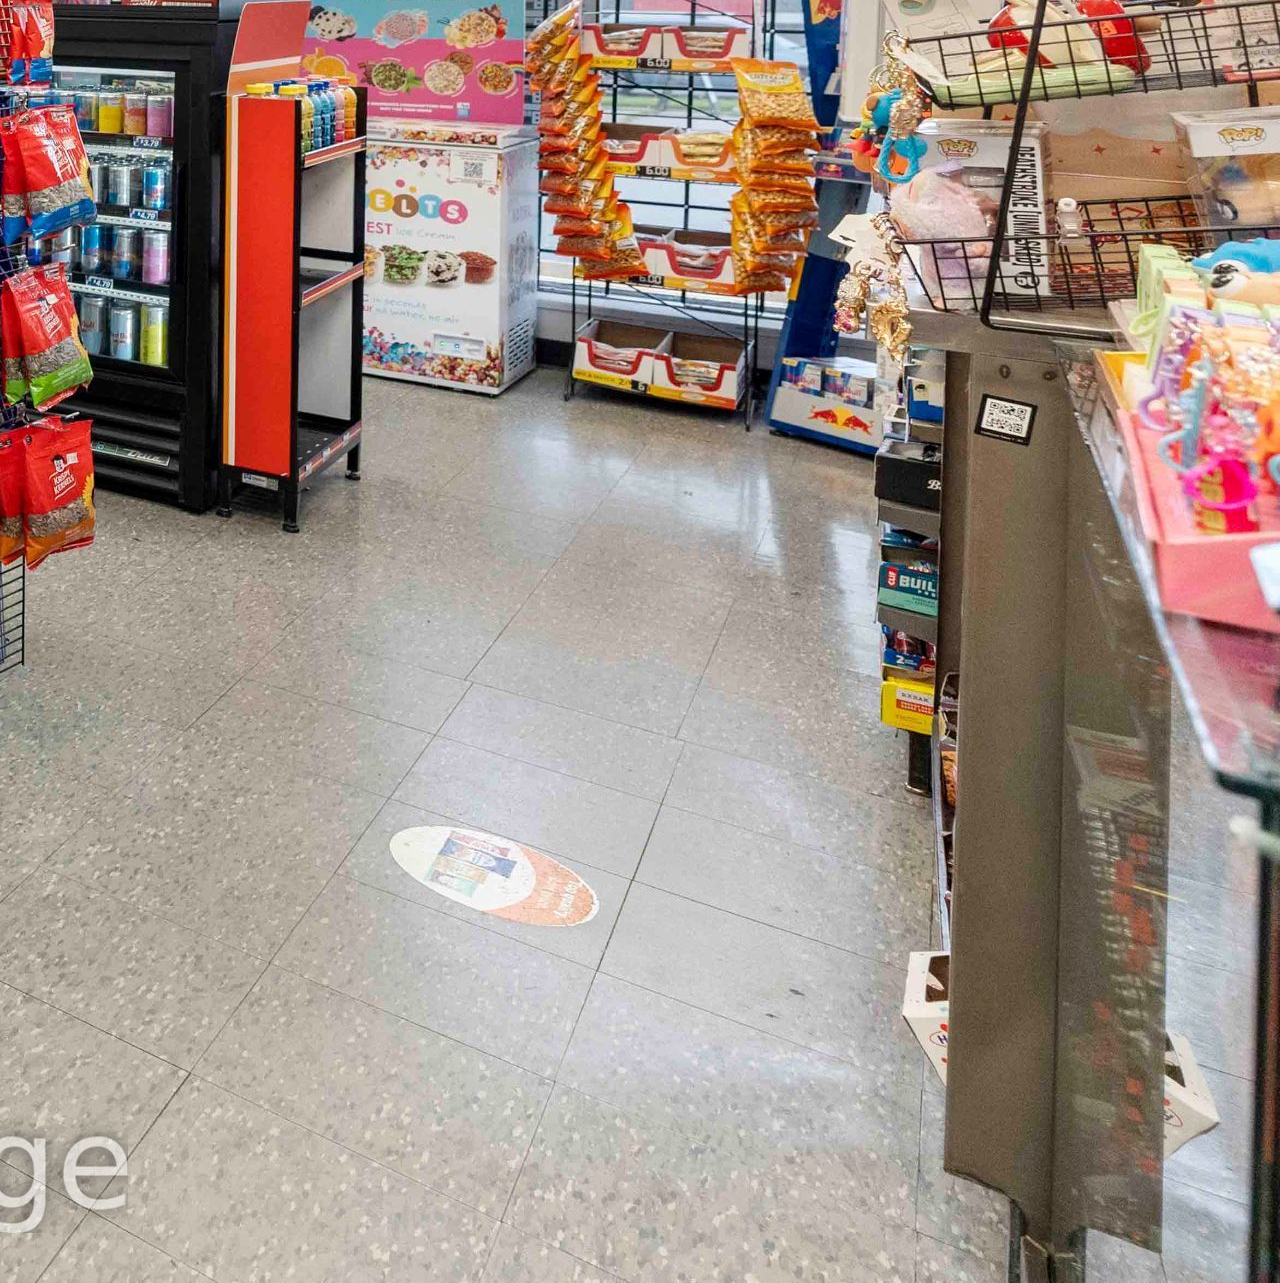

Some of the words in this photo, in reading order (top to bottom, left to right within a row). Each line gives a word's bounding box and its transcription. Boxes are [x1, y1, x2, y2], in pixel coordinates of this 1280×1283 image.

[646, 59, 670, 67] 6.00
[1218, 126, 1265, 142] POP!
[940, 139, 977, 153] POP!
[645, 166, 669, 176] 6.00
[1011, 146, 1039, 208] DEATHSTROKE
[375, 194, 460, 219] ELTS
[53, 469, 71, 485] KRISPY
[54, 477, 76, 497] KERNELS
